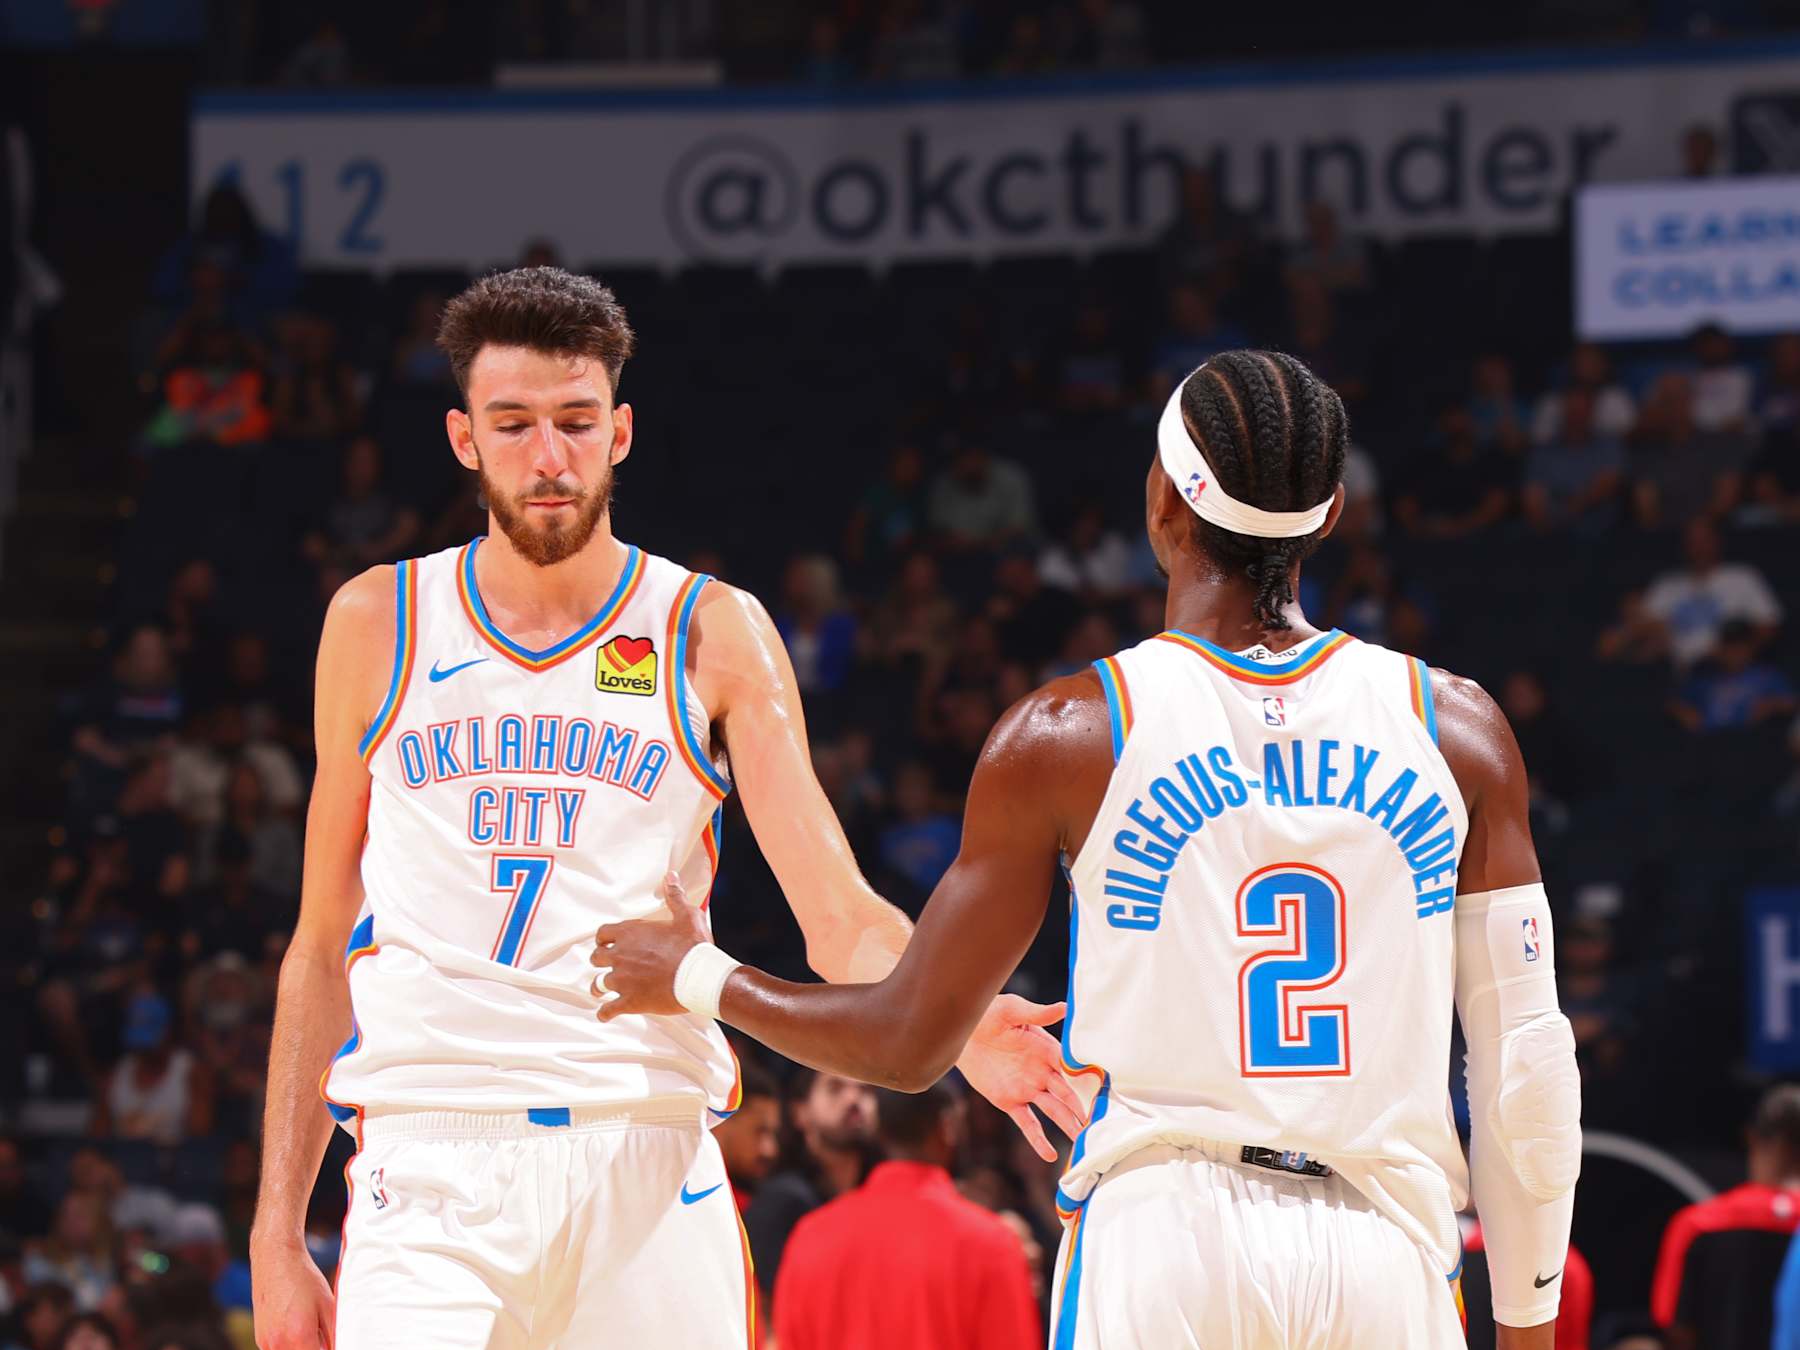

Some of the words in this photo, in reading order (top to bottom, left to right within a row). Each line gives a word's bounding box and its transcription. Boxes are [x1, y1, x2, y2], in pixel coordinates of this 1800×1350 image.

[398, 714, 672, 801] OKLAHOMA
[468, 786, 586, 848] CITY
[1104, 739, 1458, 932] GILGEOUS-ALEXANDER
[489, 852, 555, 968] 7
[1235, 861, 1352, 1078] 2
